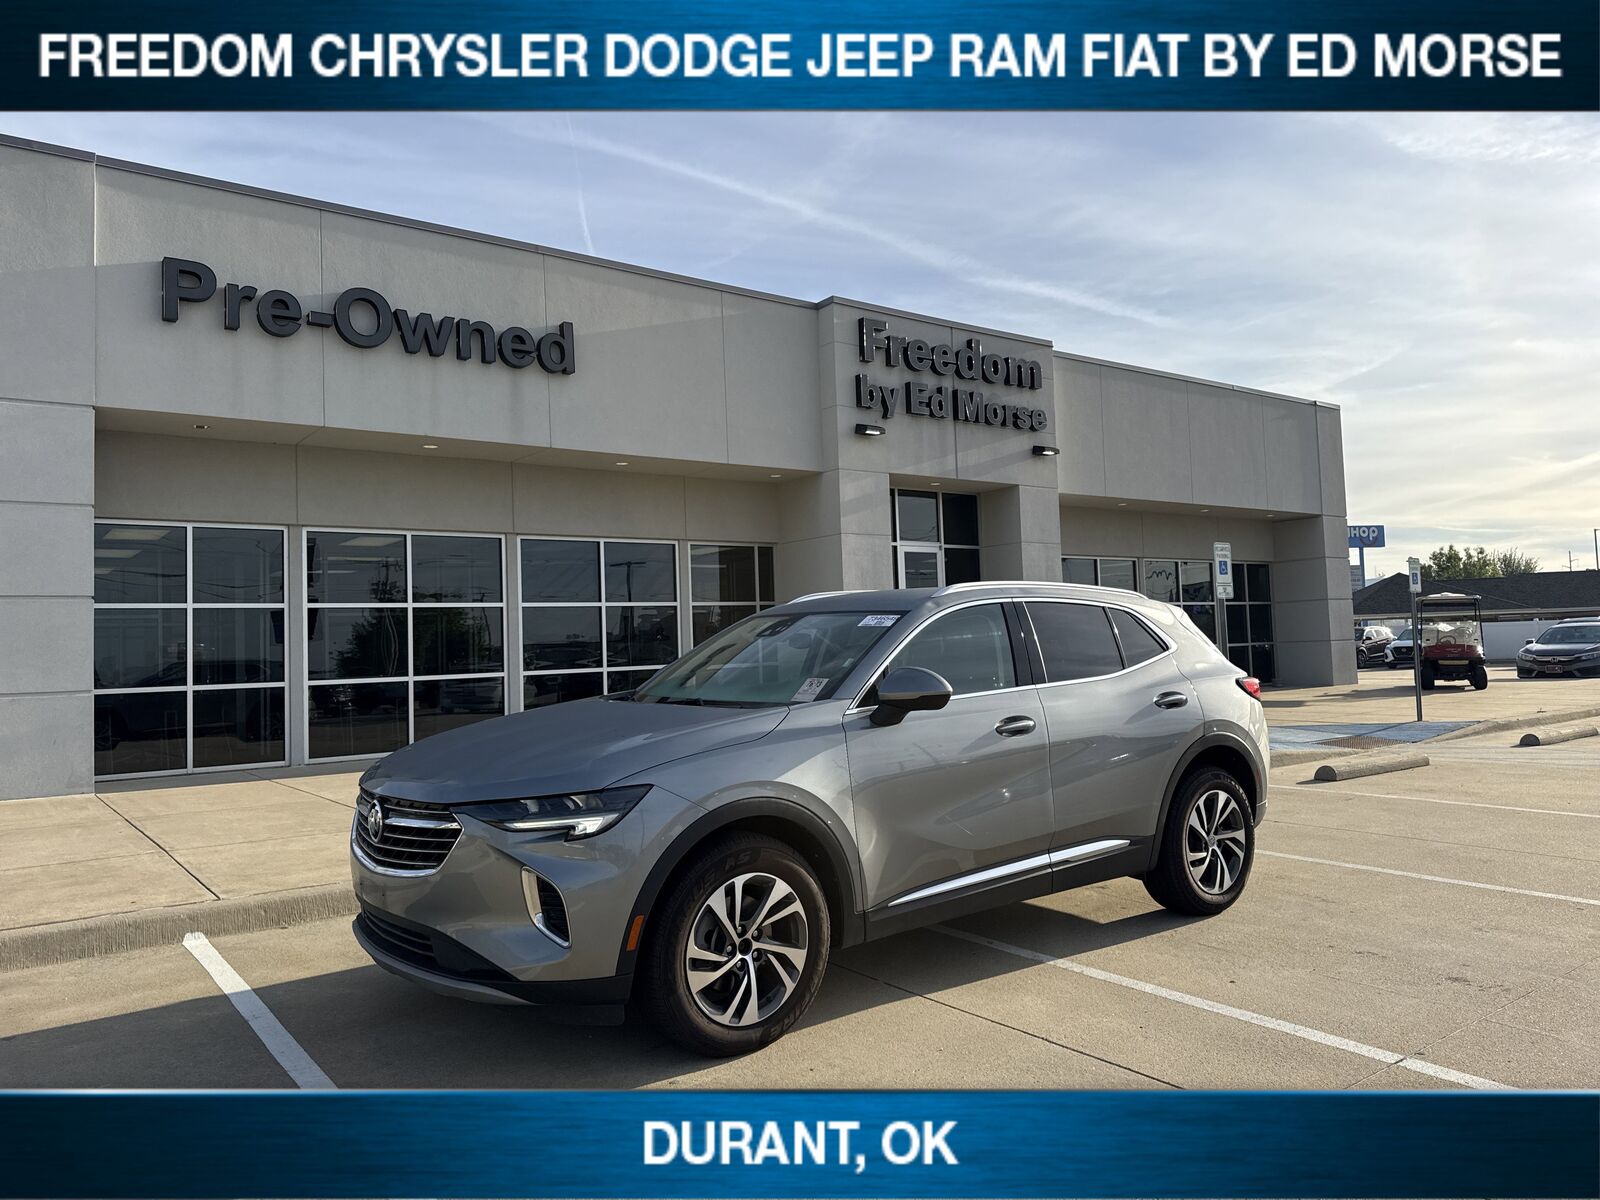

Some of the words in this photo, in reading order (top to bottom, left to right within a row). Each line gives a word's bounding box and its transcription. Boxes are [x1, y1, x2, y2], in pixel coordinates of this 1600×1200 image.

[161, 256, 576, 376] Pre-Owned
[858, 317, 1043, 389] Freedom
[855, 373, 899, 419] by
[905, 381, 949, 418] Ed
[953, 388, 1048, 431] Morse
